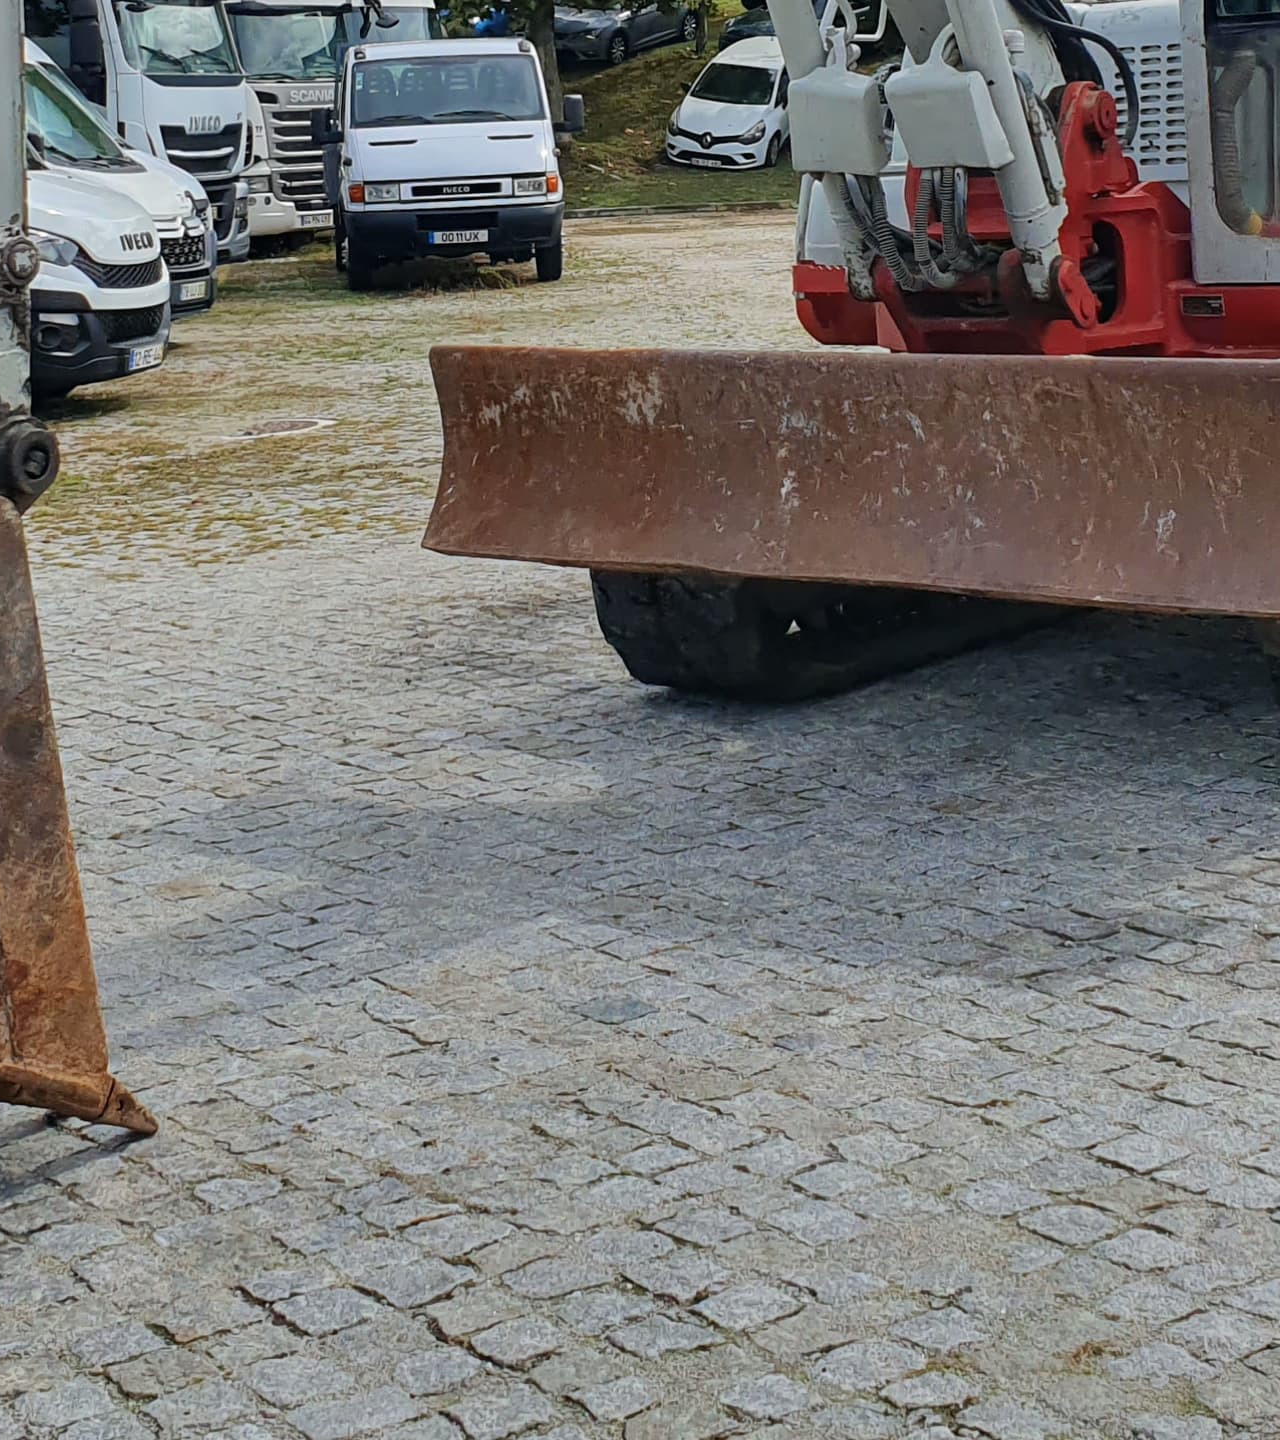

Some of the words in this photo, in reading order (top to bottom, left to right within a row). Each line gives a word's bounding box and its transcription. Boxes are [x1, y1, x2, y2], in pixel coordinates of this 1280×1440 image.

[290, 89, 335, 103] SCANIA
[189, 115, 221, 132] IVECO
[442, 186, 471, 194] IVECO
[120, 231, 154, 251] IVECO
